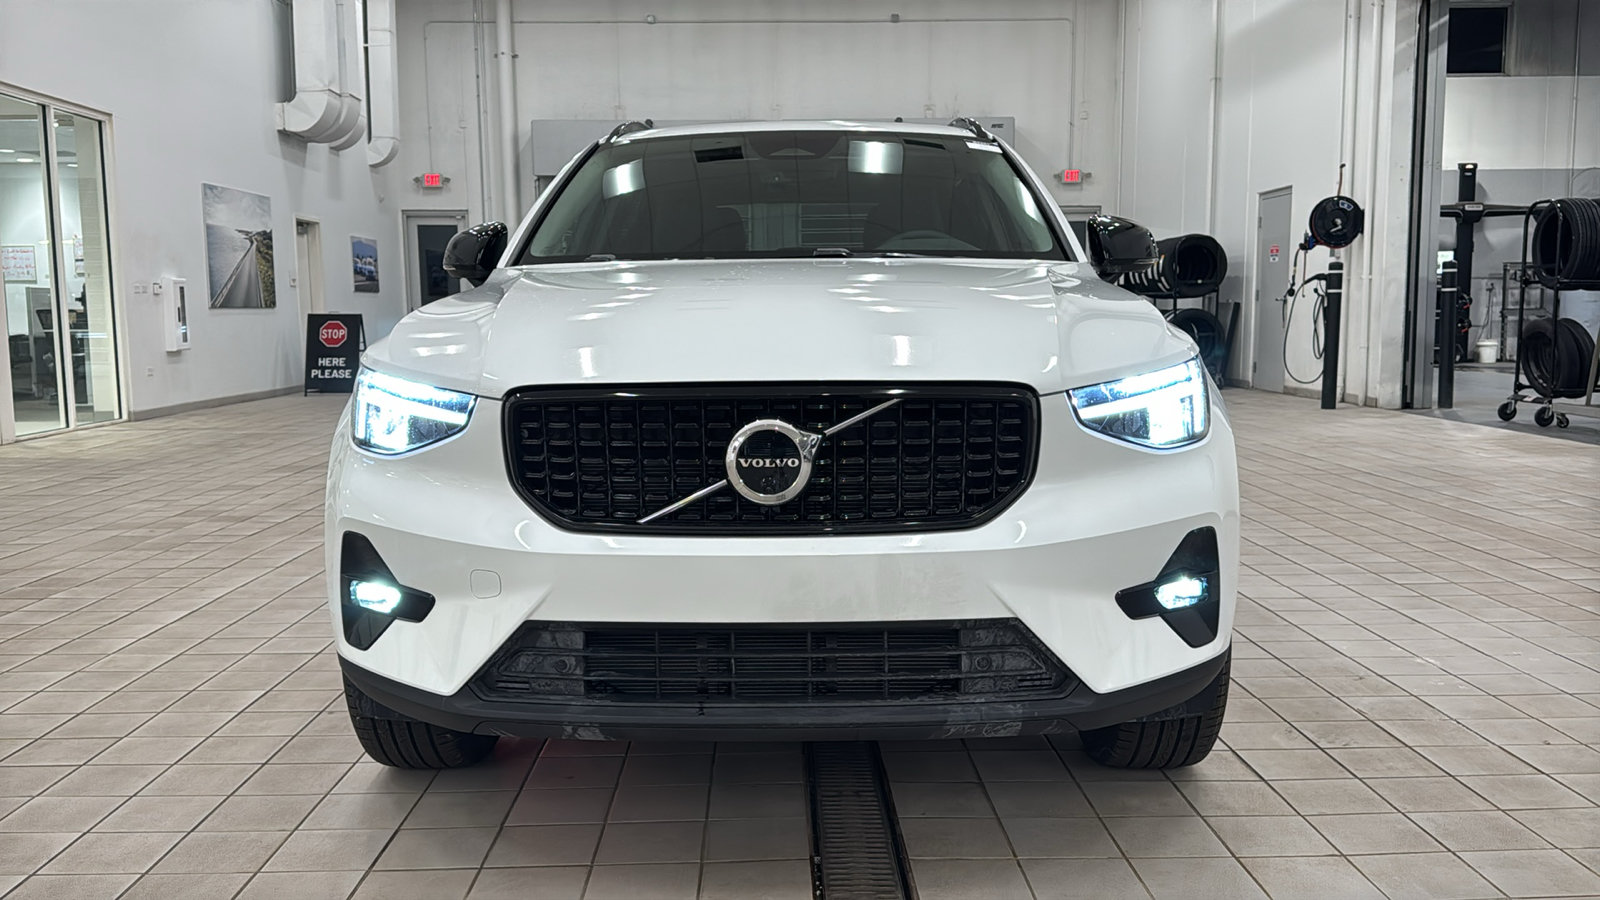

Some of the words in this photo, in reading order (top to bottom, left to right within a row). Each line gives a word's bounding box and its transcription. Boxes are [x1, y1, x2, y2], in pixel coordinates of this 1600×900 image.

[321, 329, 345, 339] STOP
[318, 357, 346, 367] HERE
[310, 369, 352, 379] PLEASE
[738, 458, 800, 468] VOLVO
